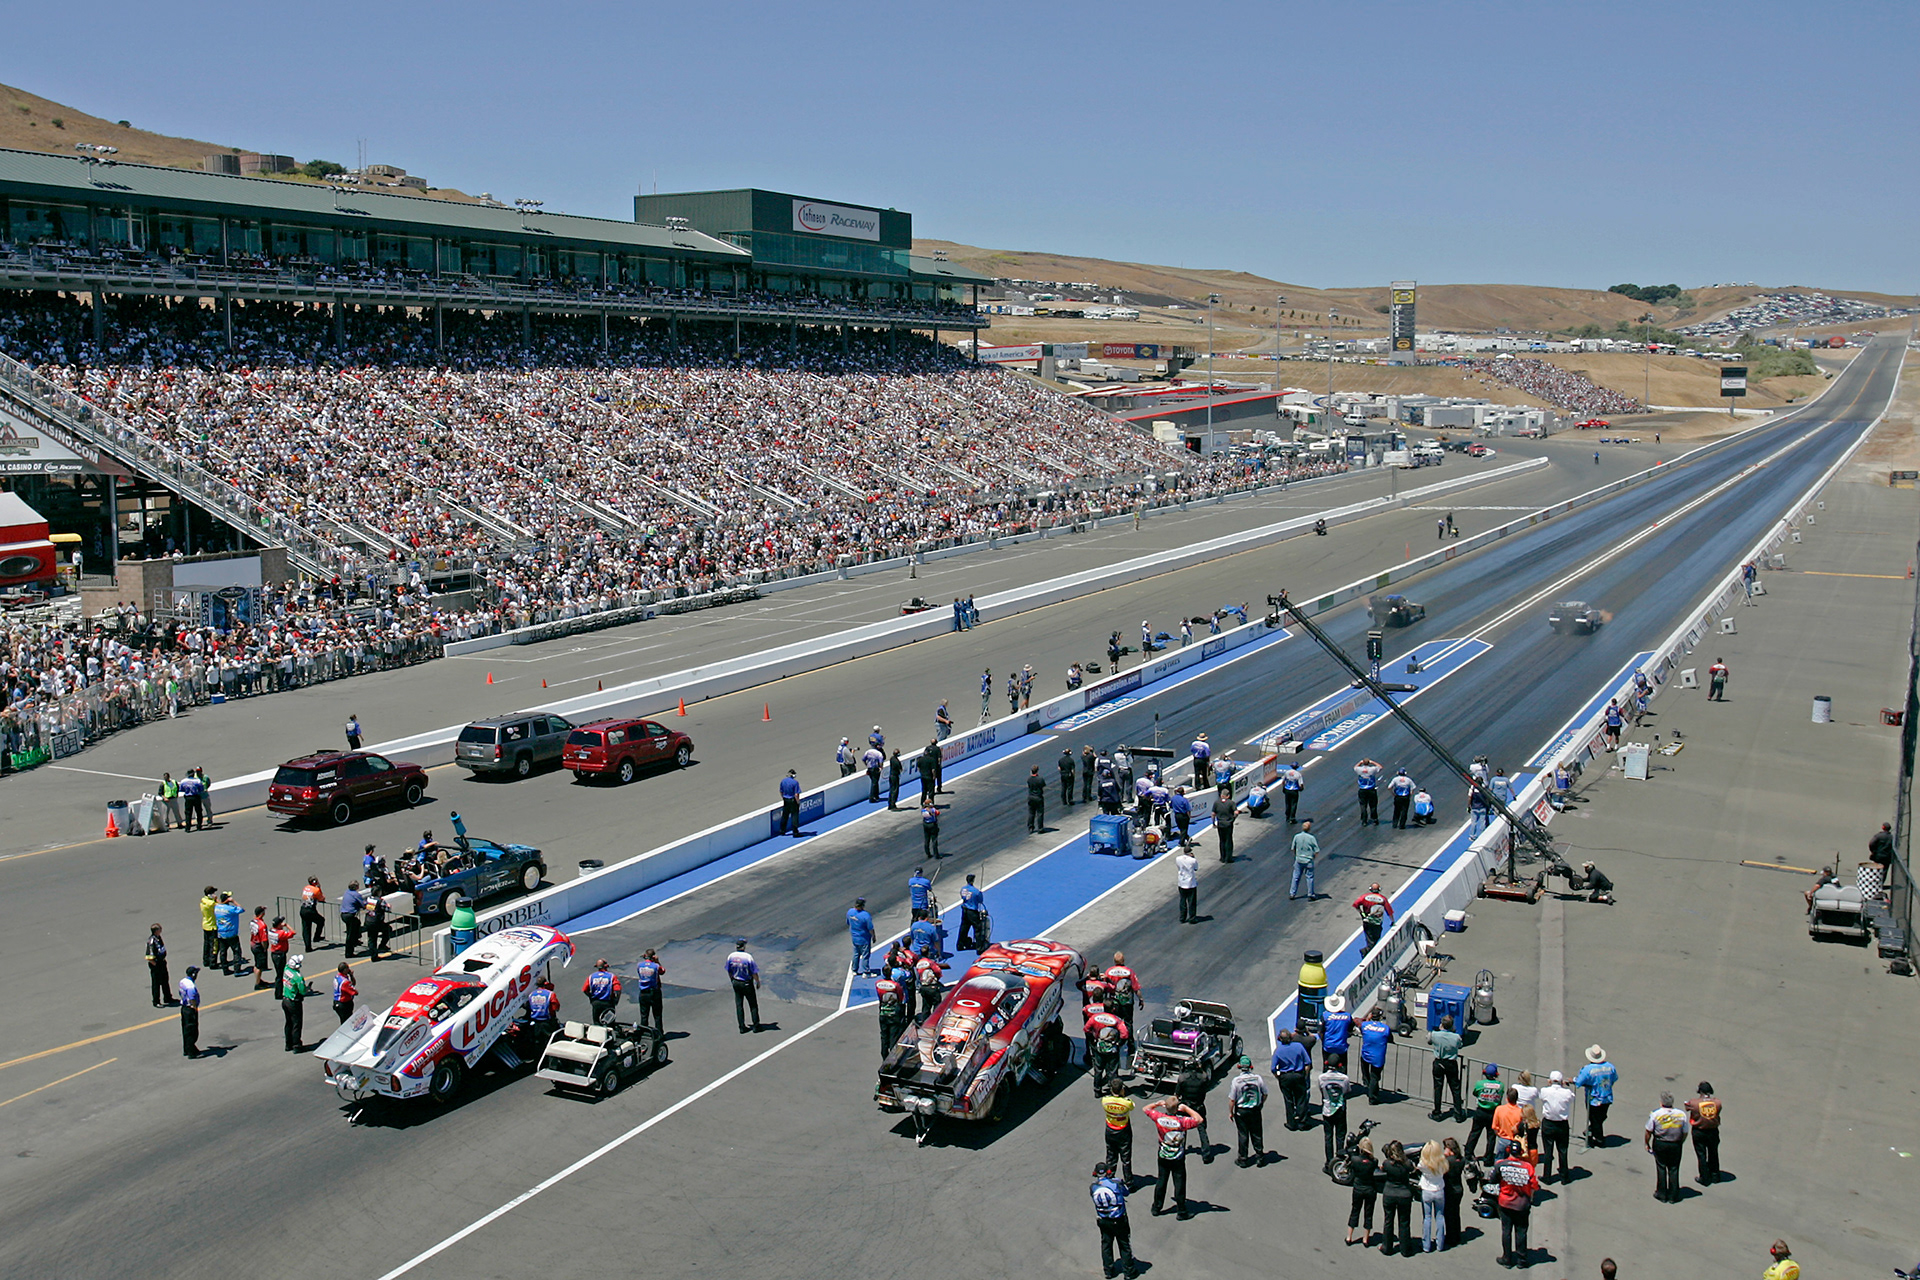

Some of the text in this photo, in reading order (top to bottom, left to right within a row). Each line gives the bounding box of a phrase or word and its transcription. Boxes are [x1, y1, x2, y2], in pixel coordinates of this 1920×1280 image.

[802, 206, 875, 232] Infineon RACEWAY
[7, 463, 32, 471] CASINO
[1089, 673, 1139, 702] jacksoncasino.com
[1325, 708, 1340, 726] FRAM
[966, 728, 996, 753] NATIONALS
[476, 901, 549, 940] KORBEL
[1359, 926, 1407, 987] KORBEL
[463, 964, 532, 1049] LUCAS
[410, 1038, 445, 1073] Jim Dunn
